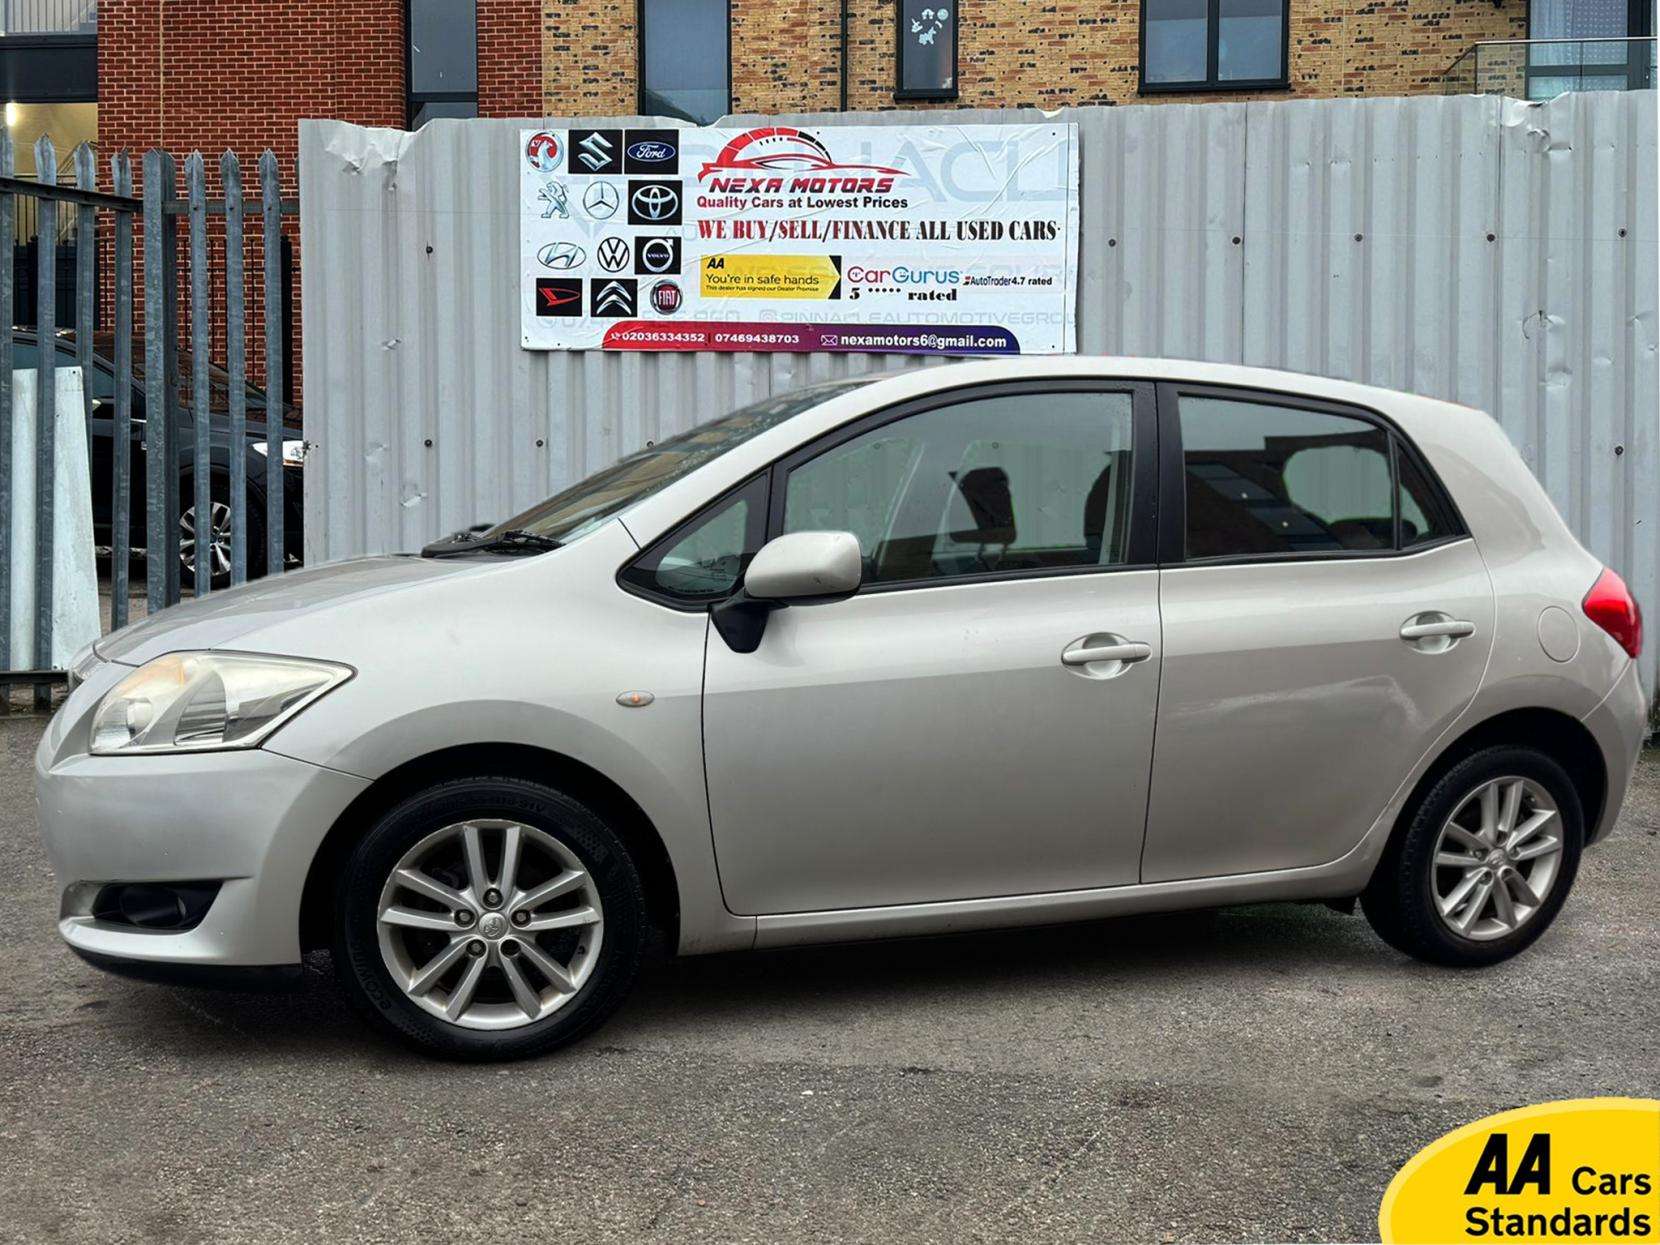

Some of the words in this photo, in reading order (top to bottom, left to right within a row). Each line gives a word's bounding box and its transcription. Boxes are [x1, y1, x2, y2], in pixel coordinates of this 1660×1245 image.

[635, 144, 667, 159] Ford
[709, 177, 784, 193] NEXA
[789, 177, 895, 194] MOTORS
[697, 196, 750, 210] Quality
[751, 196, 784, 208] Cars
[788, 197, 803, 208] at
[807, 196, 859, 208] Lowest
[863, 196, 908, 209] Prices
[698, 219, 727, 240] WE
[732, 219, 911, 243] BUY/SELL/FINANCE
[915, 220, 951, 241] ALL
[956, 220, 1004, 241] USED
[1008, 220, 1057, 241] CARS
[706, 257, 725, 270] AA
[705, 273, 741, 285] You're
[744, 273, 755, 284] in
[757, 274, 782, 285] safe
[783, 274, 820, 286] hands
[846, 265, 960, 285] CarGurus
[1027, 277, 1053, 286] rated
[658, 289, 677, 306] FIAT
[849, 287, 861, 300] 5
[908, 288, 958, 301] rated
[622, 333, 705, 342] 02036334352
[714, 333, 800, 344] 07469438703
[840, 334, 1007, 349] nexamotors6@gmail.com
